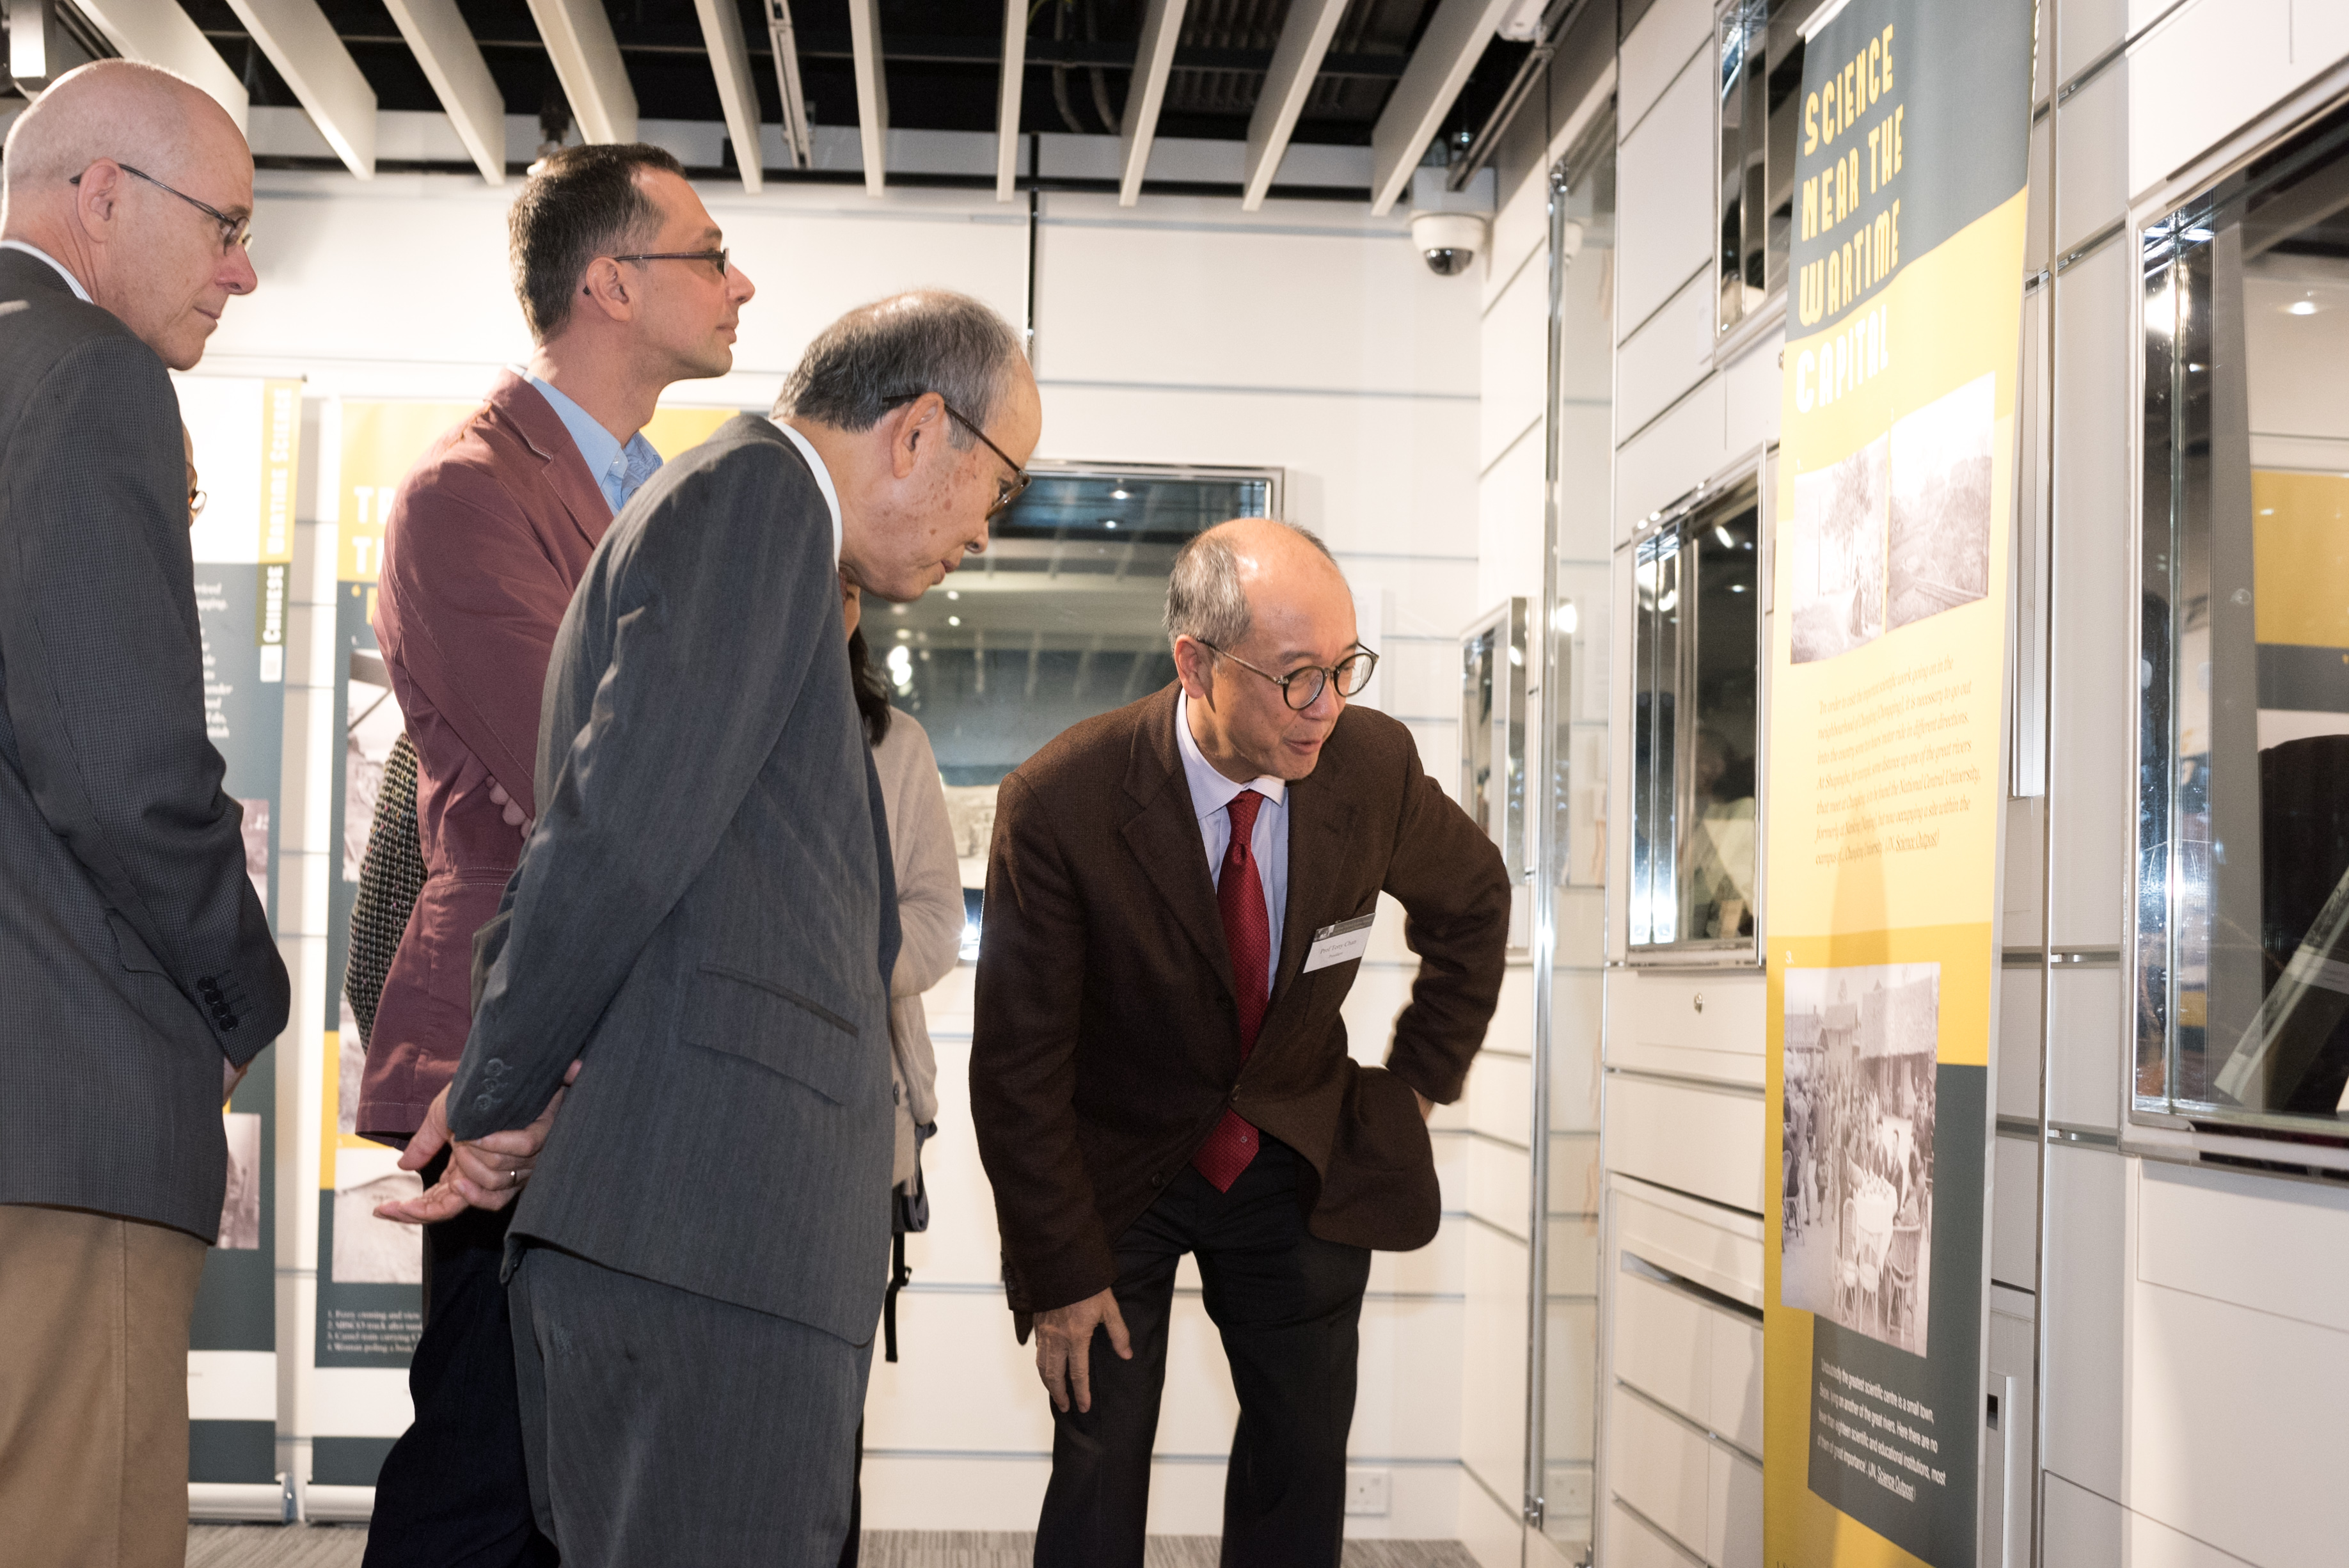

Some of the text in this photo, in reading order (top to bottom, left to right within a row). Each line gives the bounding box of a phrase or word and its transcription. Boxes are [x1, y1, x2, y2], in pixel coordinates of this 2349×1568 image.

[1804, 23, 1894, 157] SCIENCE
[1801, 104, 1904, 242] NEAR THE
[1799, 198, 1901, 327] WARTIME
[1795, 303, 1889, 413] CAPITAL
[264, 388, 292, 643] CHINESE WARTIME SCIENCE
[1897, 666, 1911, 686] work
[1911, 663, 1928, 686] going
[1929, 663, 1936, 676] on
[1937, 657, 1943, 674] in
[1943, 653, 1954, 672] the
[1916, 690, 1943, 707] necessary
[1943, 686, 1950, 699] to
[1950, 685, 1959, 702] go
[1960, 679, 1972, 695] out
[1817, 749, 1830, 765] into
[1895, 722, 1906, 740] ride
[1913, 717, 1936, 739] different
[1817, 776, 1824, 790] At
[1901, 754, 1908, 771] up
[1909, 752, 1919, 765] one
[1919, 745, 1926, 766] of
[1926, 743, 1934, 761] the
[1934, 743, 1951, 763] great
[1952, 738, 1972, 755] rivers
[1816, 799, 1829, 816] that
[1899, 774, 1923, 795] National
[1924, 769, 1945, 789] Central
[1814, 821, 1839, 844] formerly
[1895, 804, 1923, 825] occupying
[1928, 800, 1938, 817] site
[1938, 795, 1959, 815] within
[1959, 794, 1970, 812] the
[1864, 1380, 1883, 1400] scientific
[1906, 1399, 1919, 1416] small
[1920, 1404, 1934, 1423] town,
[1871, 1411, 1883, 1427] great
[1896, 1420, 1908, 1439] Here
[1908, 1427, 1920, 1446] there
[1920, 1434, 1929, 1450] are
[1930, 1438, 1938, 1453] no
[1878, 1441, 1903, 1465] educational
[1931, 1468, 1946, 1486] most
